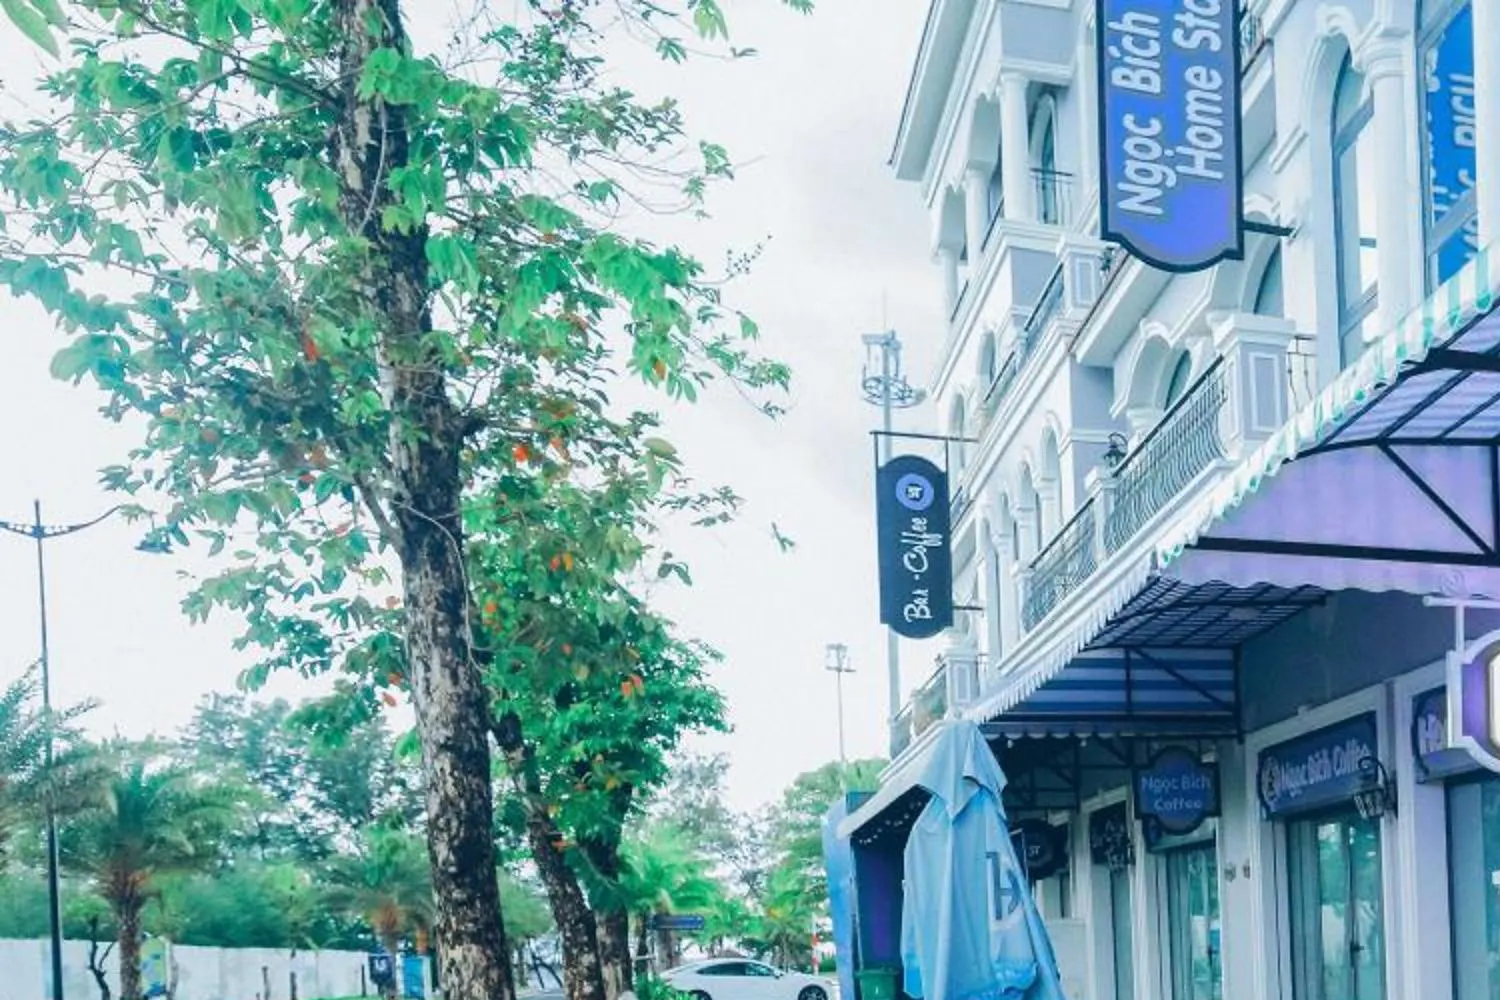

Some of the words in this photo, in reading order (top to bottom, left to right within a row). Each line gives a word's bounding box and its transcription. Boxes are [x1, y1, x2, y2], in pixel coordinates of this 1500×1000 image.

[1107, 11, 1161, 94] Bích
[1175, 65, 1224, 179] Home
[1117, 113, 1177, 215] Ngọc
[900, 517, 943, 573] Coffee
[904, 588, 932, 623] Bar
[1153, 797, 1203, 811] Coffee
